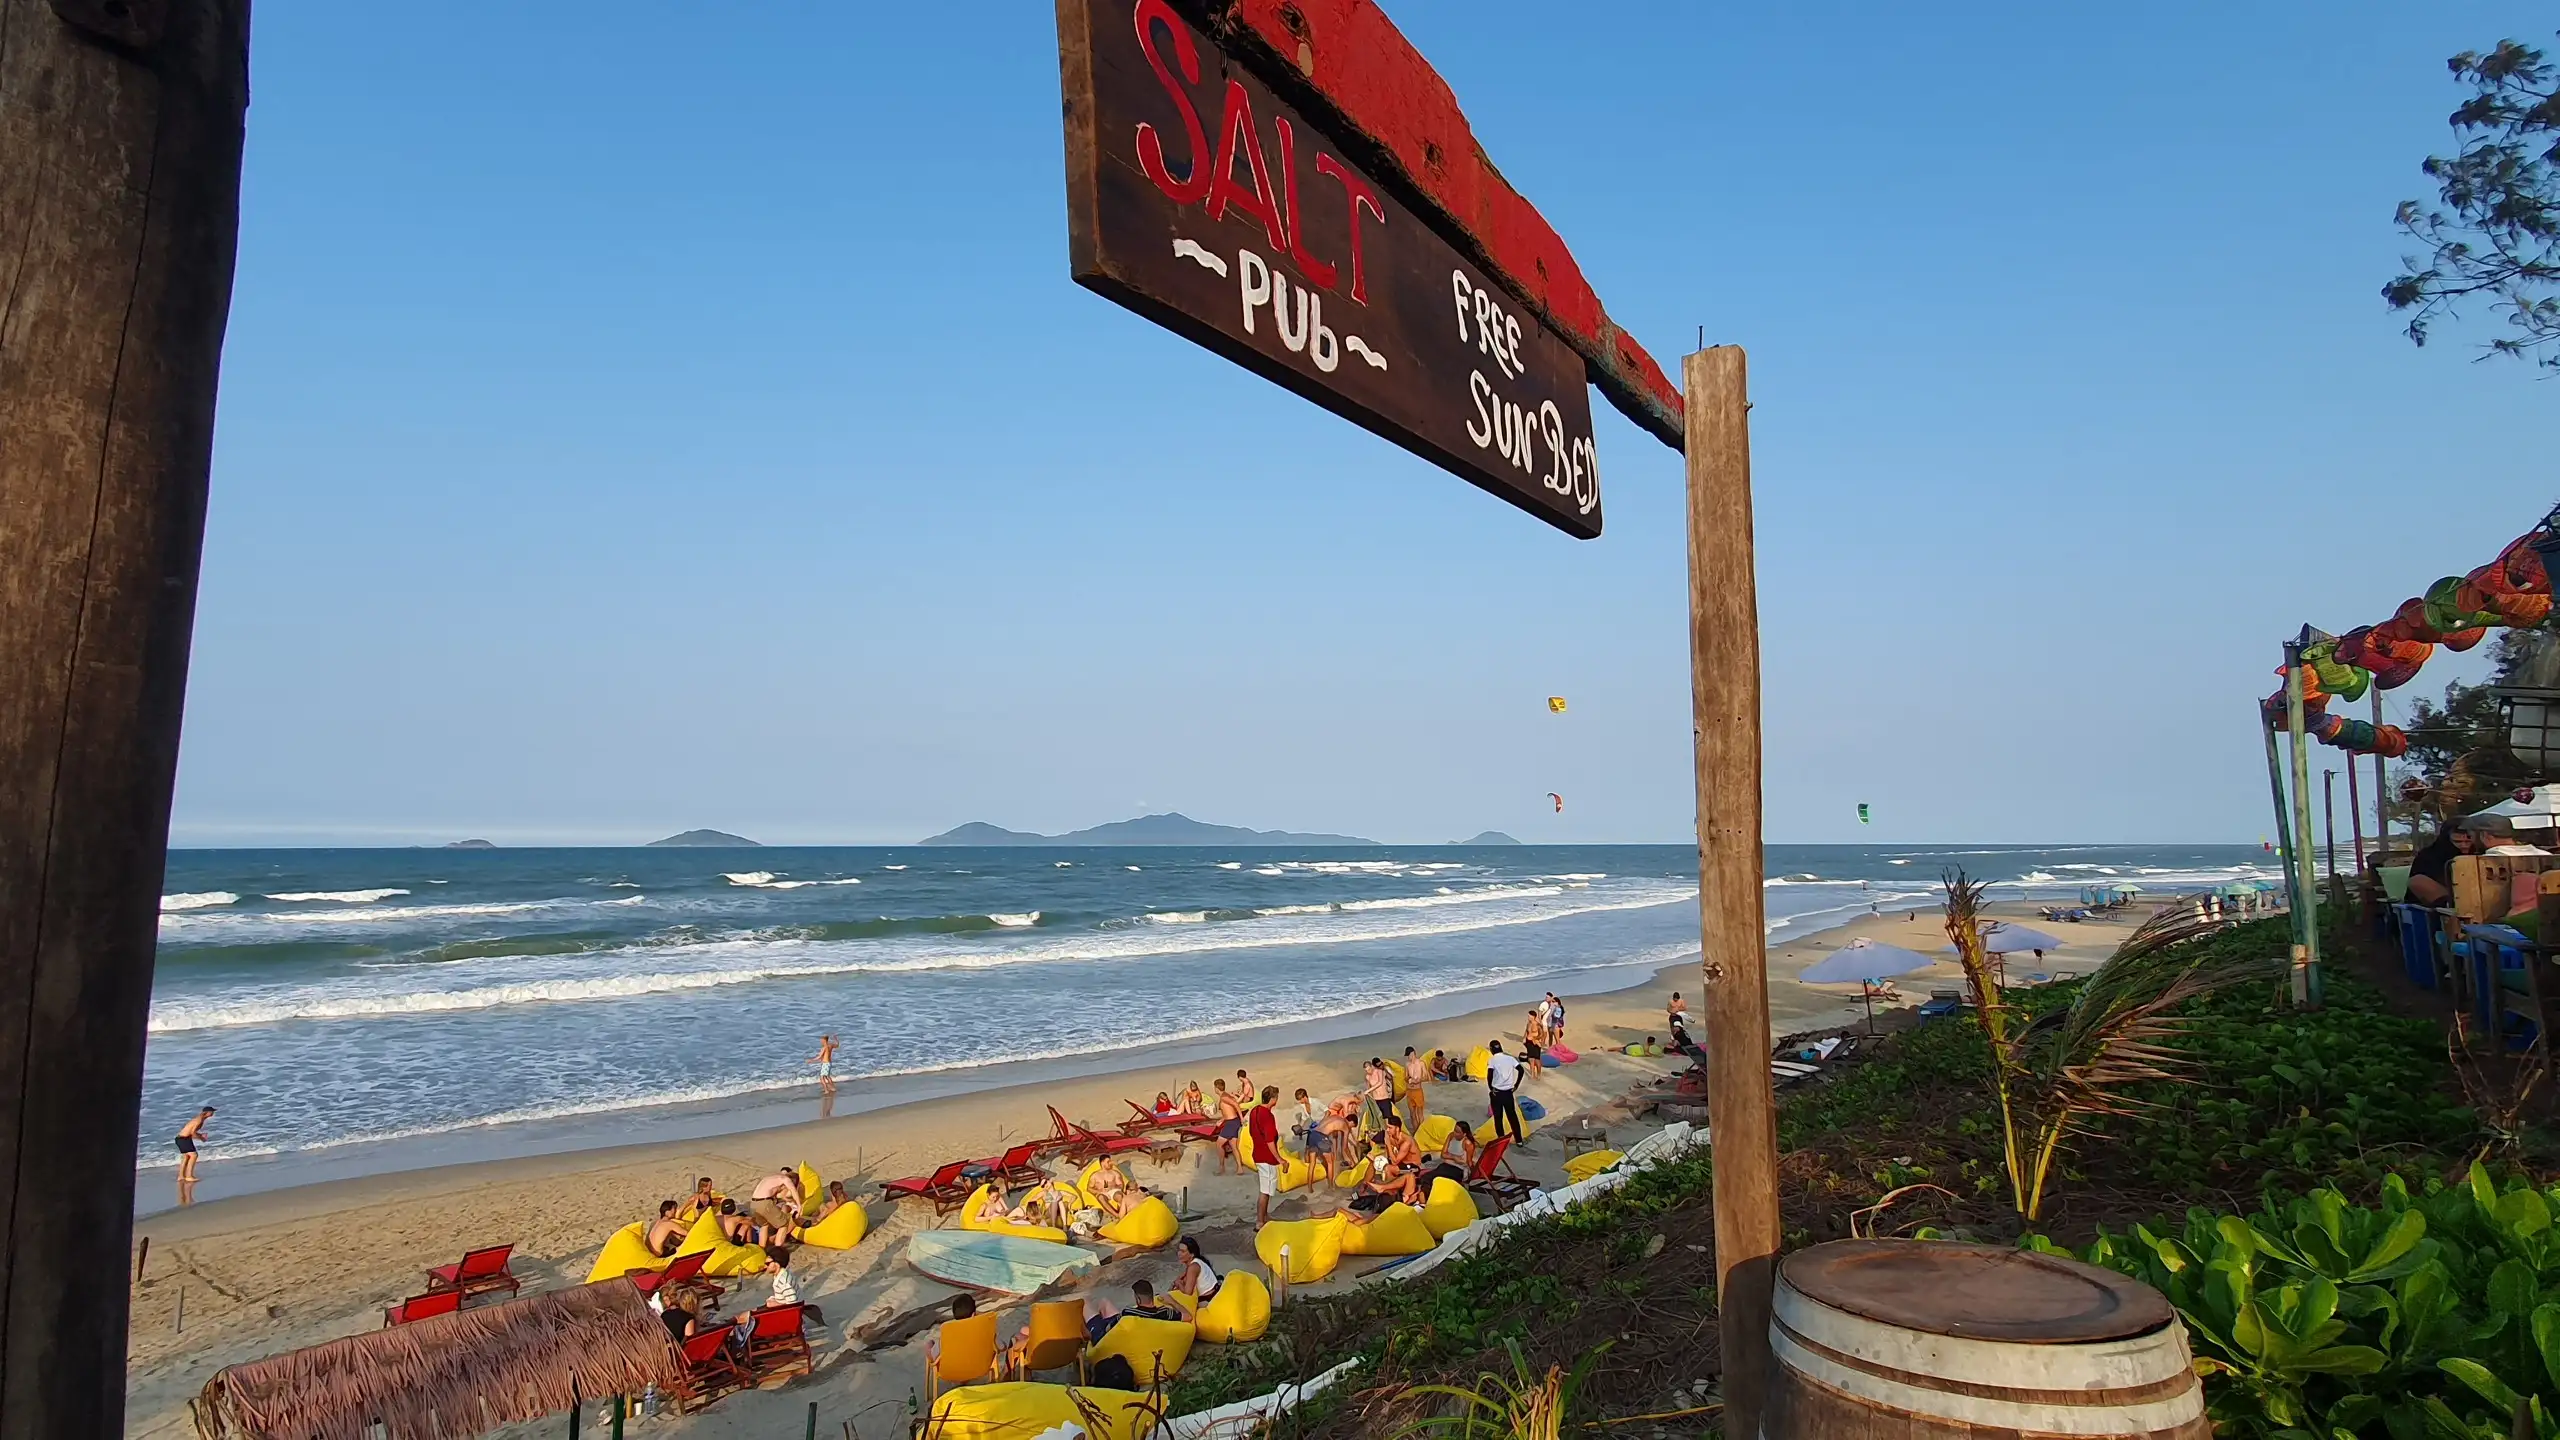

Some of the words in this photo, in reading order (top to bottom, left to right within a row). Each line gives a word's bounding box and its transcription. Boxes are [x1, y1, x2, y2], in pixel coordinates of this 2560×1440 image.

[1134, 0, 1385, 307] SALT
[1452, 269, 1524, 380] FREE
[1466, 369, 1538, 474] SUN
[1541, 399, 1598, 515] BED
